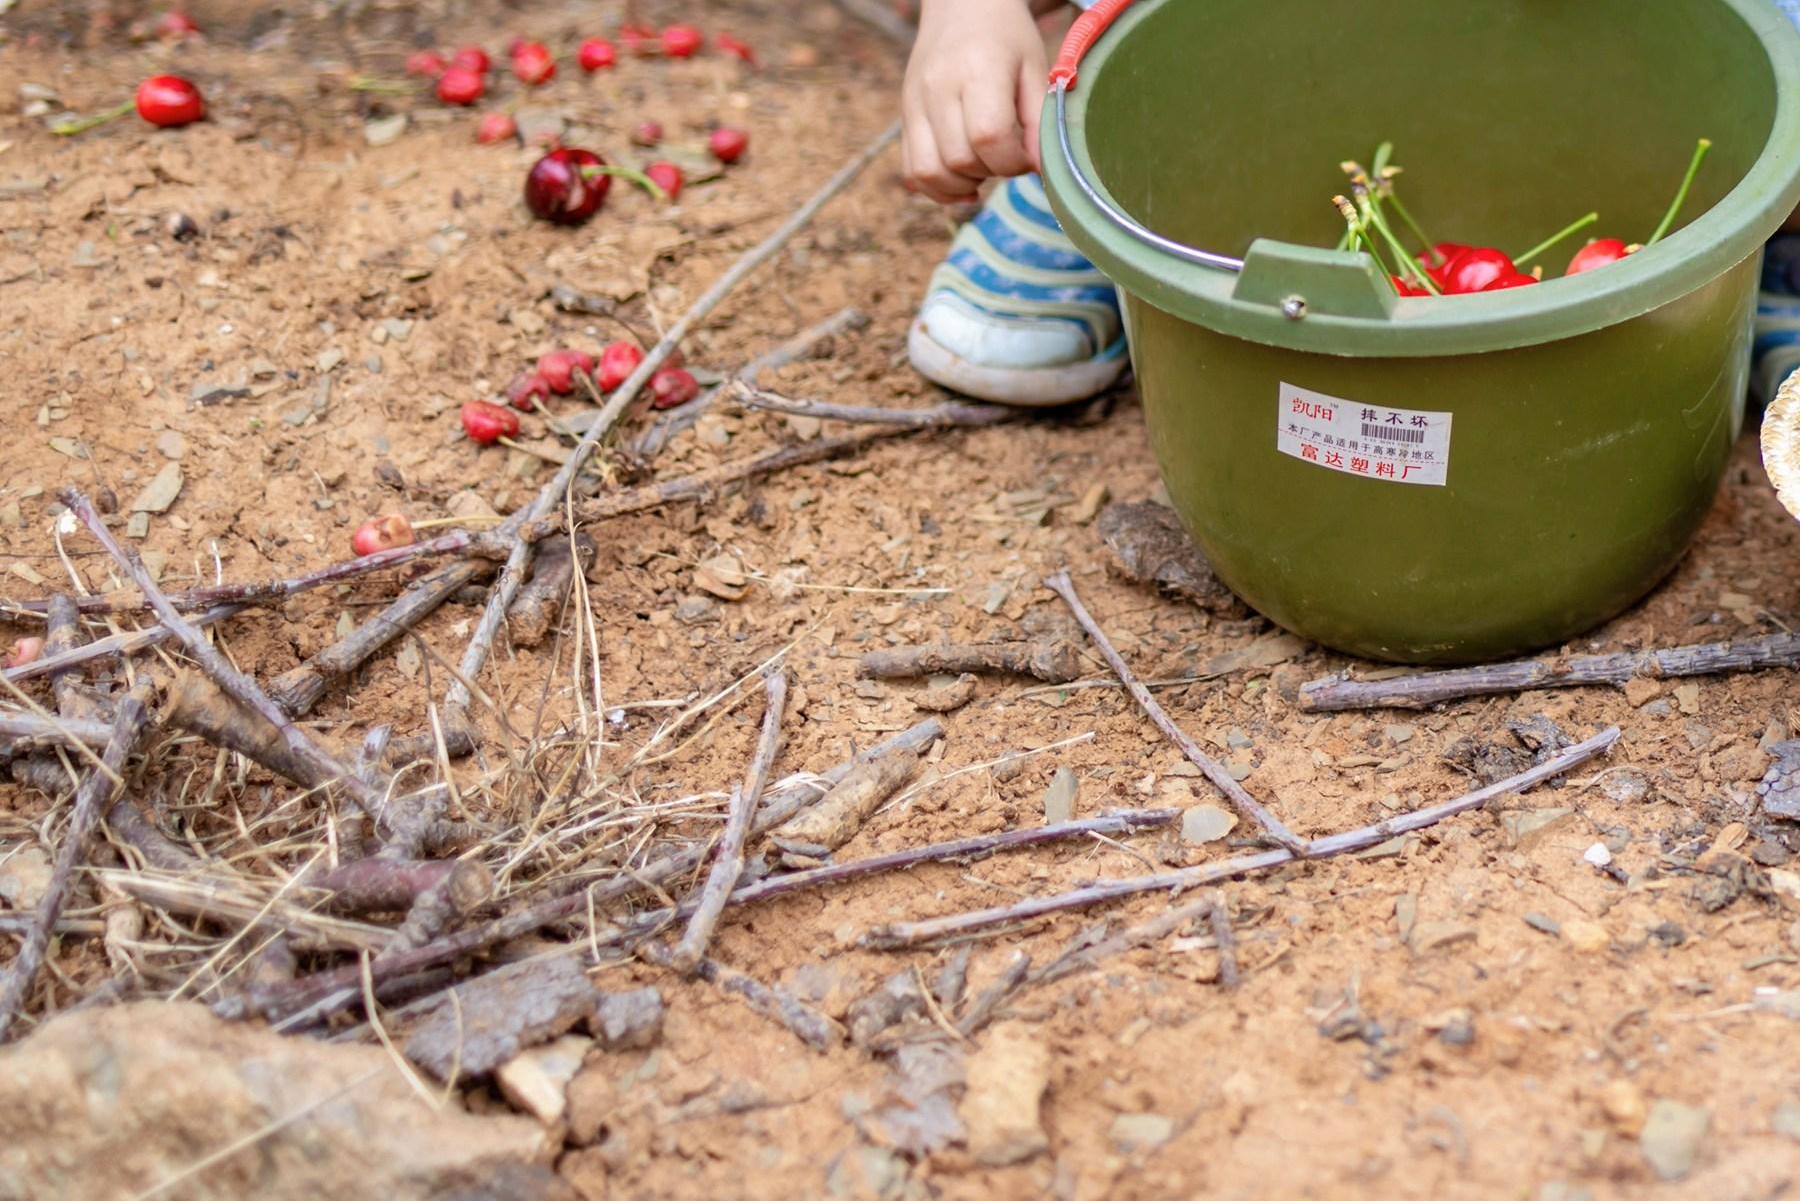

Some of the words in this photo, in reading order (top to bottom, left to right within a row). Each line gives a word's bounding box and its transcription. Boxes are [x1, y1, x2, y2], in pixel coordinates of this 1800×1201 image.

[1292, 398, 1333, 421] 凯阳
[1361, 407, 1429, 428] 摔不坏
[1288, 423, 1435, 460] 本厂产品适用于高寒冷地区
[1301, 444, 1422, 479] 富达塑料厂
